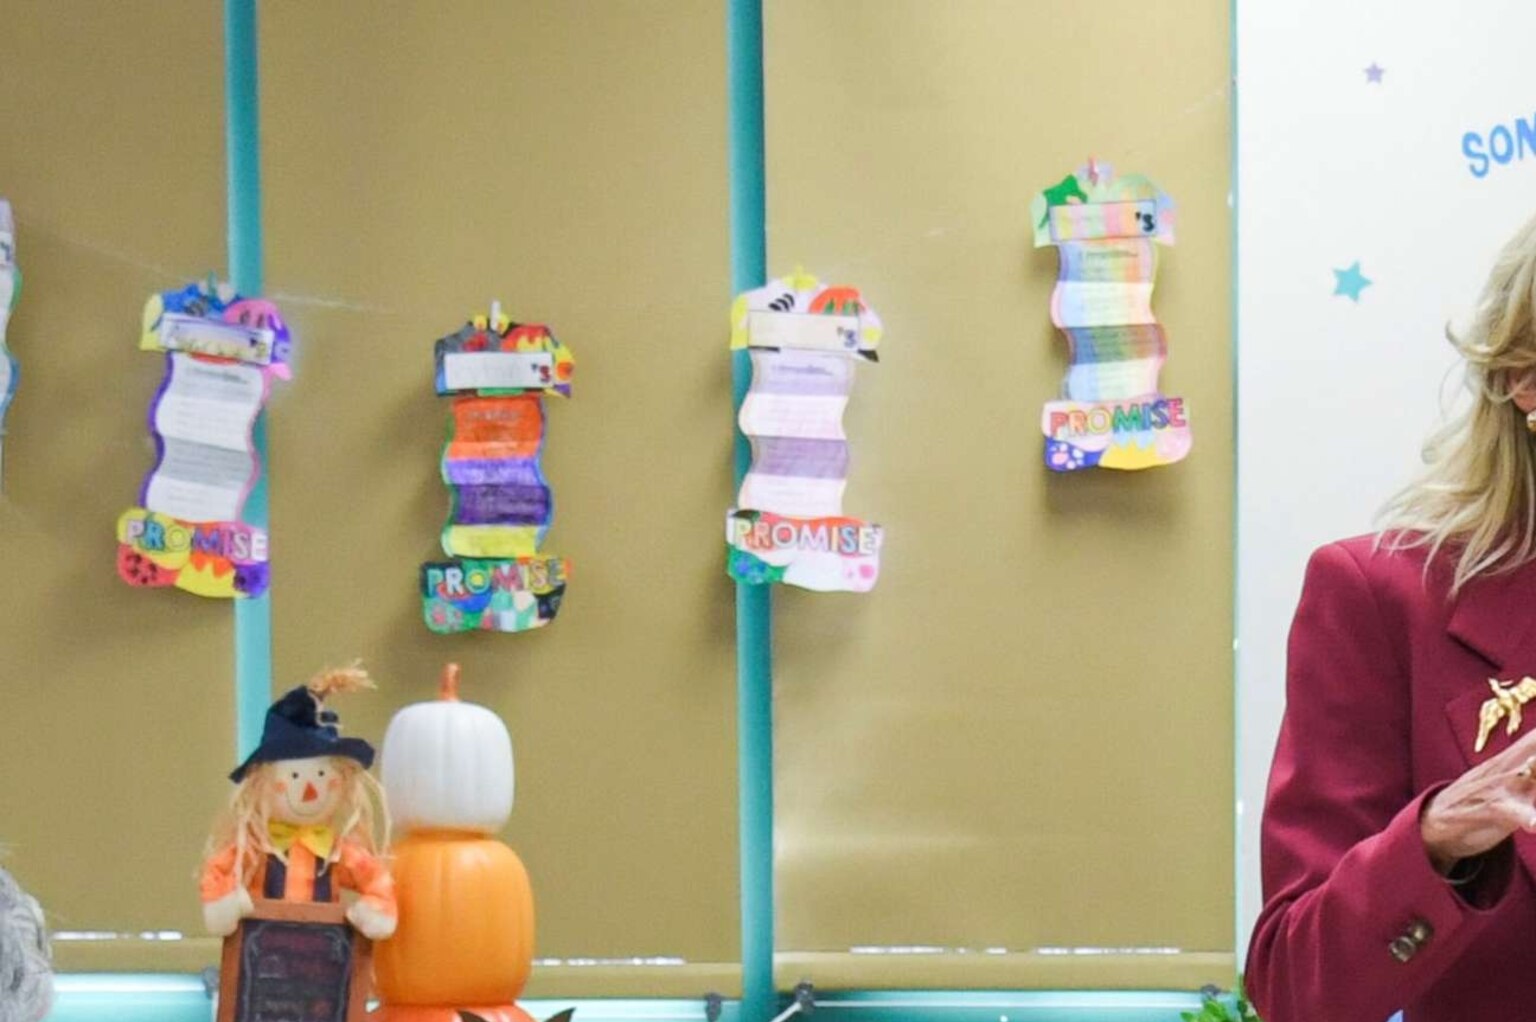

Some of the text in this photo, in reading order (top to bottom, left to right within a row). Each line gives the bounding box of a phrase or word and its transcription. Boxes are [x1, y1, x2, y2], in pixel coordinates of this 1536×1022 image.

[1050, 398, 1187, 437] PROMISE
[125, 517, 268, 562] PROMISE
[734, 517, 876, 557] PROMISE
[426, 556, 567, 599] PROMISE
